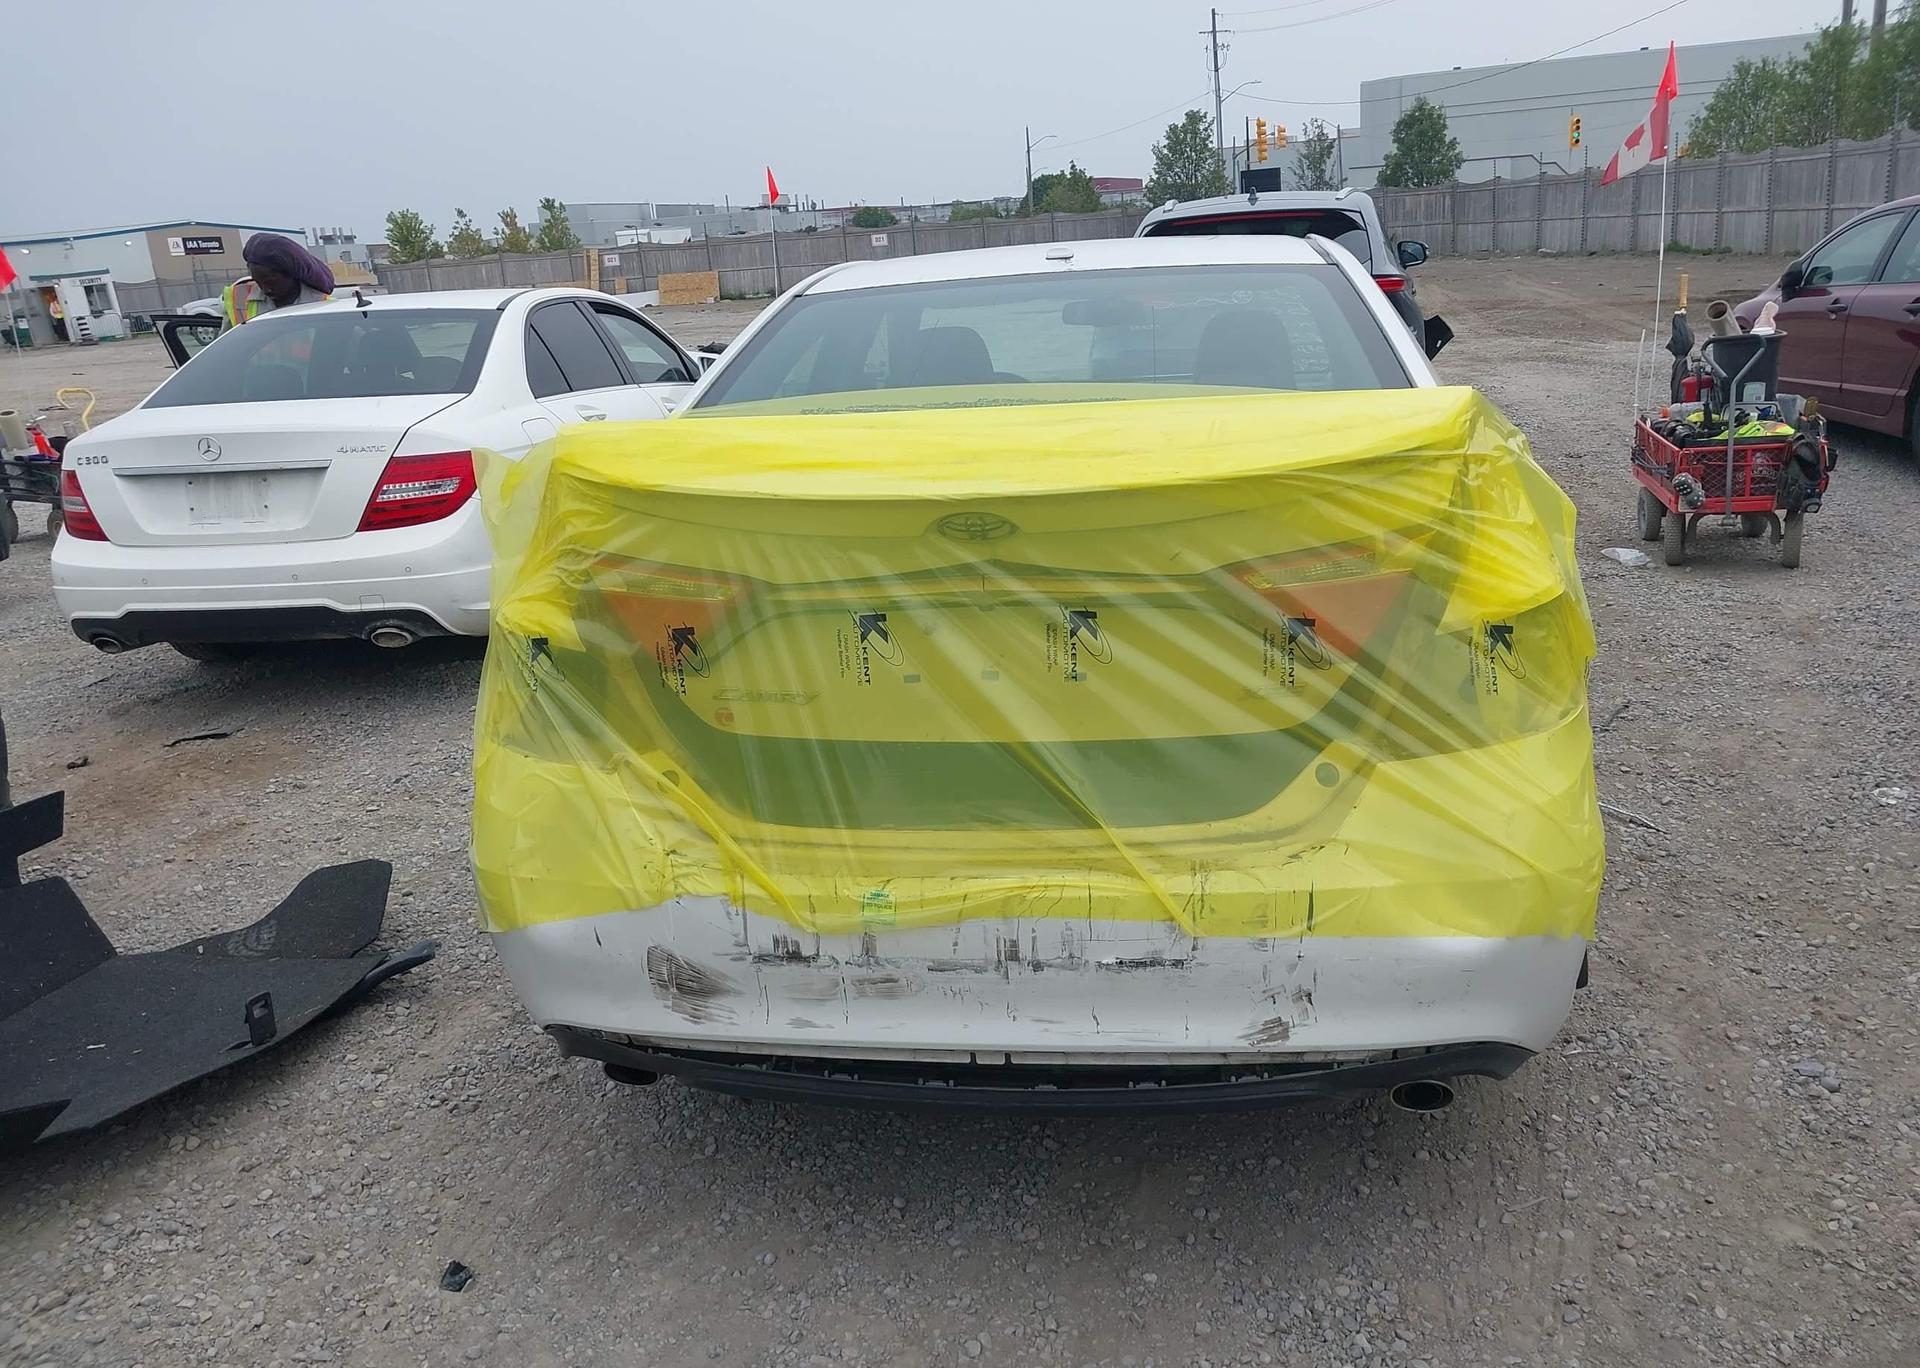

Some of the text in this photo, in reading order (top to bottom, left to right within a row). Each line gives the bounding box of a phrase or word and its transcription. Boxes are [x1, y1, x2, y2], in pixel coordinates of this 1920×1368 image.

[186, 240, 220, 249] IAA Toronto
[79, 277, 102, 285] SECURITY
[337, 445, 387, 454] 4MATIC
[677, 659, 687, 696] KENT
[862, 646, 871, 686] KENT
[1070, 642, 1078, 682] KENT
[1287, 647, 1296, 687] KENT
[1490, 656, 1499, 696] KENT
